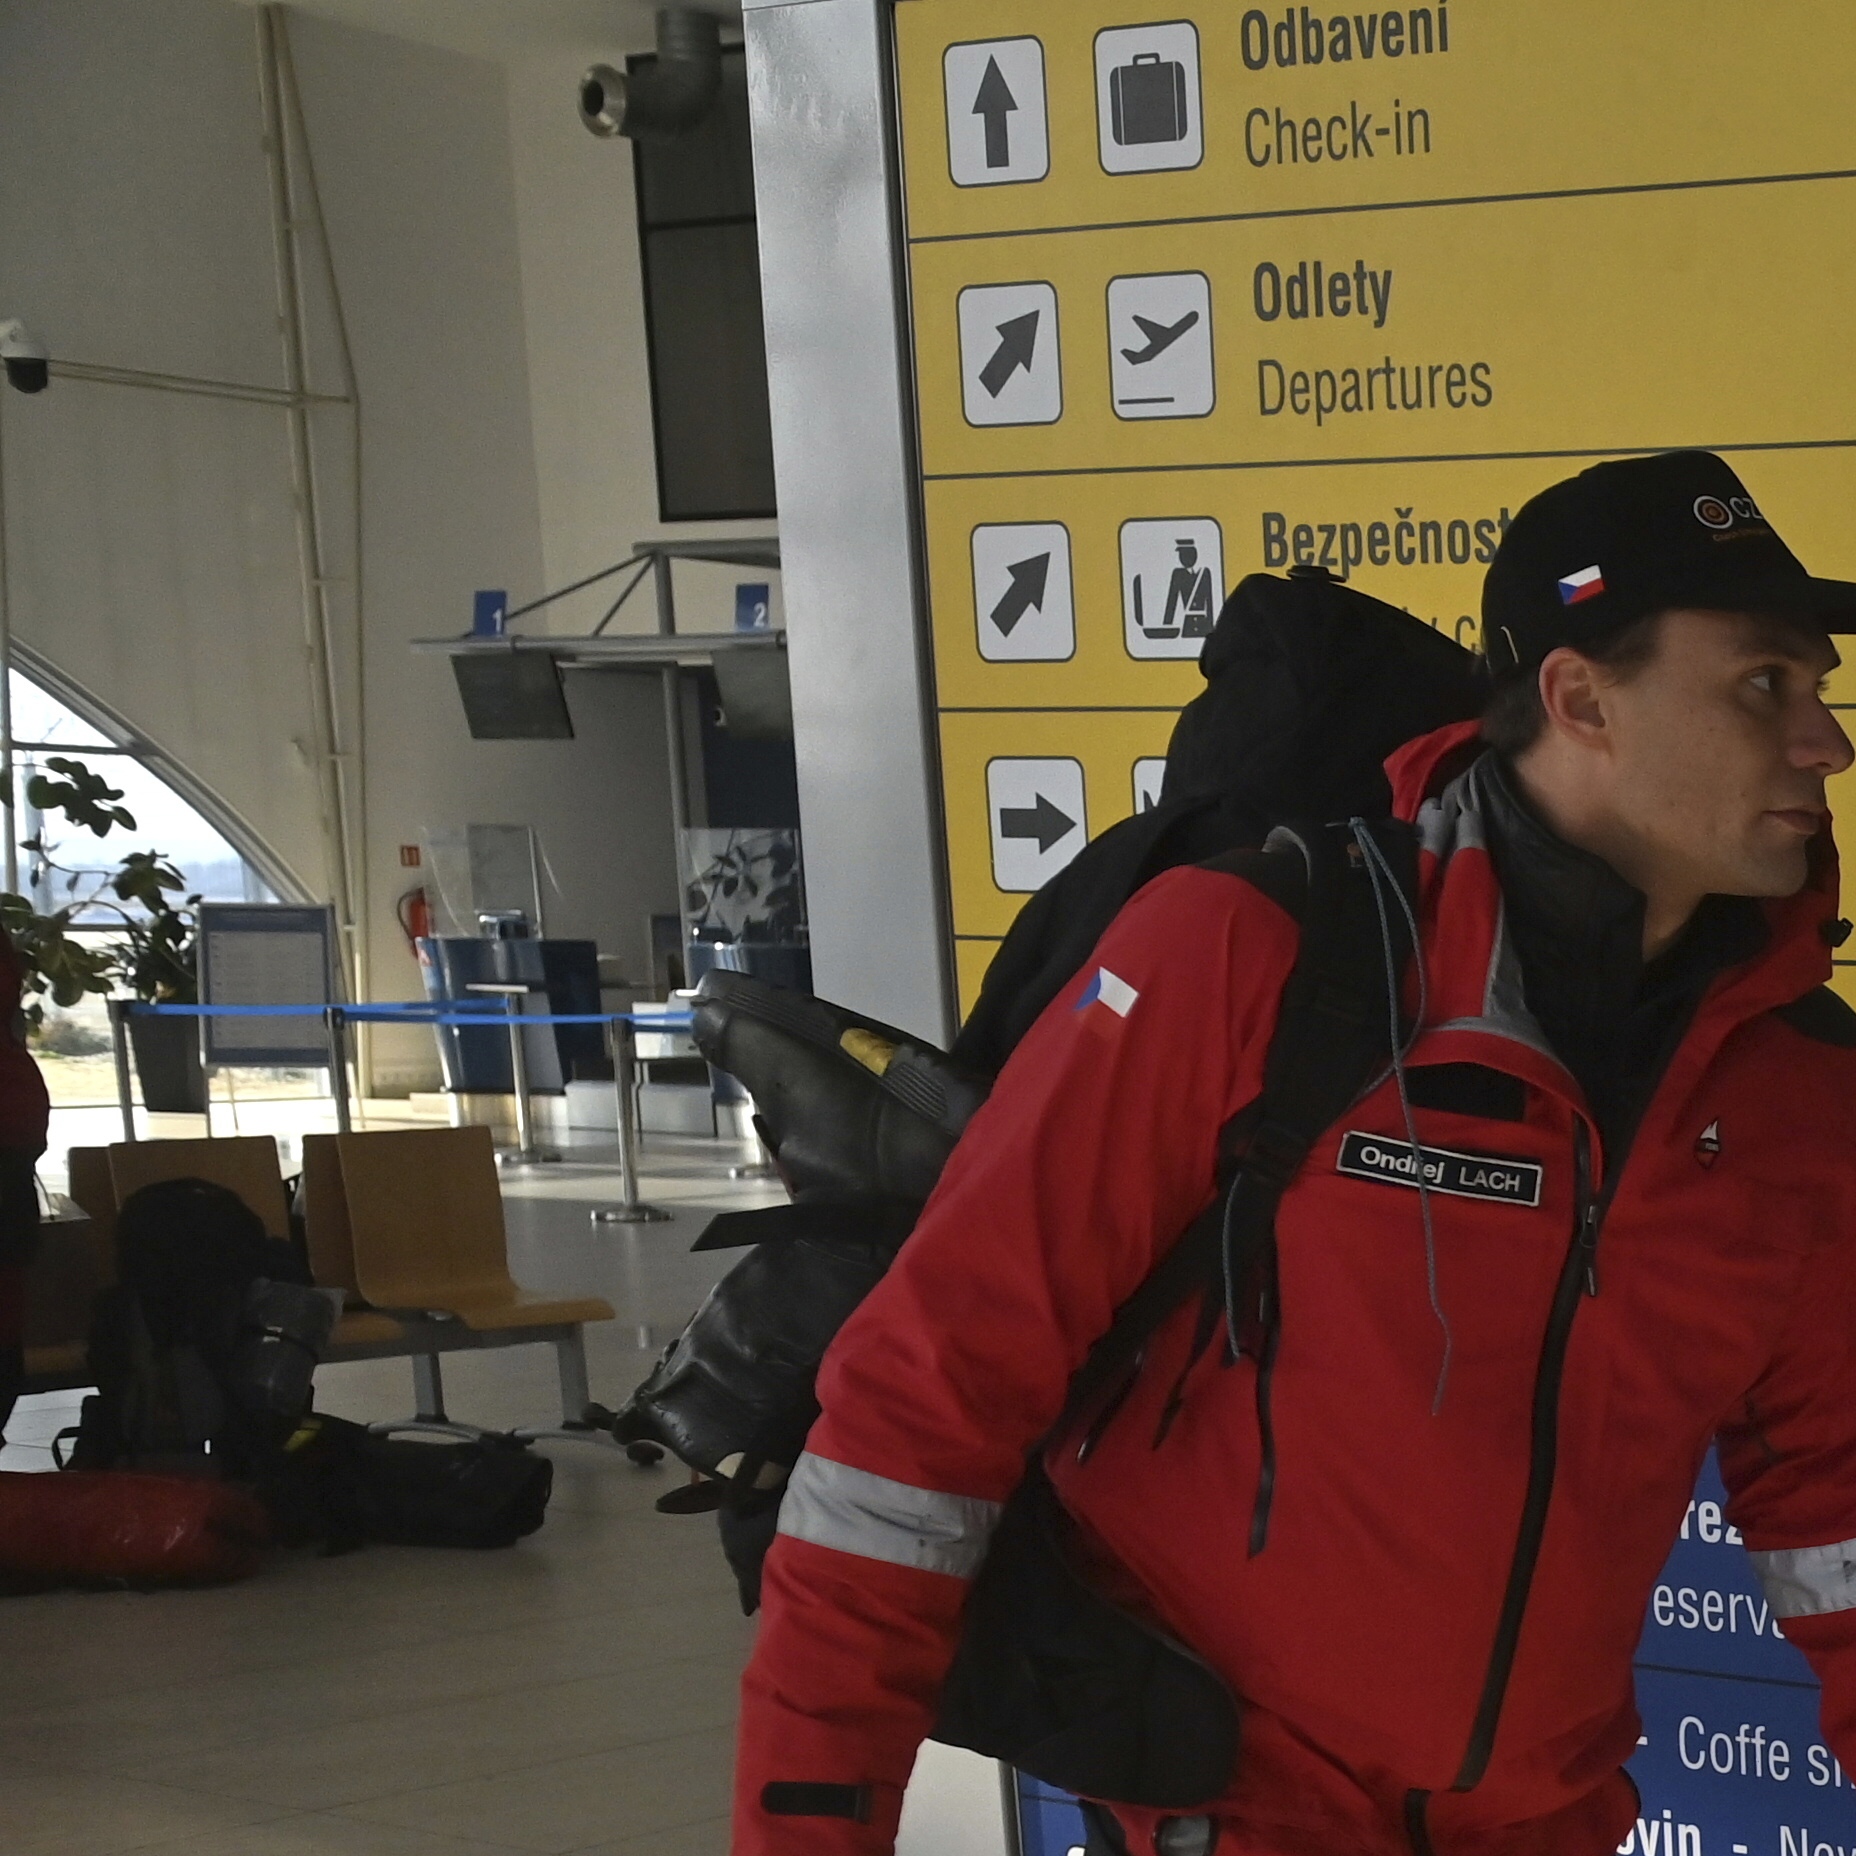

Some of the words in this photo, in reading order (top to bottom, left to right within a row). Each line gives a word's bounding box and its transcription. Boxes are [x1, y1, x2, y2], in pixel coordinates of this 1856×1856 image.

[1240, 0, 1449, 71] Odbavení
[1245, 98, 1431, 168] Check-in
[1253, 261, 1393, 328] Odlety
[1256, 355, 1493, 428] Departures
[491, 607, 504, 632] 1
[753, 602, 768, 628] 2
[1459, 1166, 1521, 1192] LACH
[1653, 1584, 1786, 1640] eserv
[1678, 1715, 1790, 1782] Coffe
